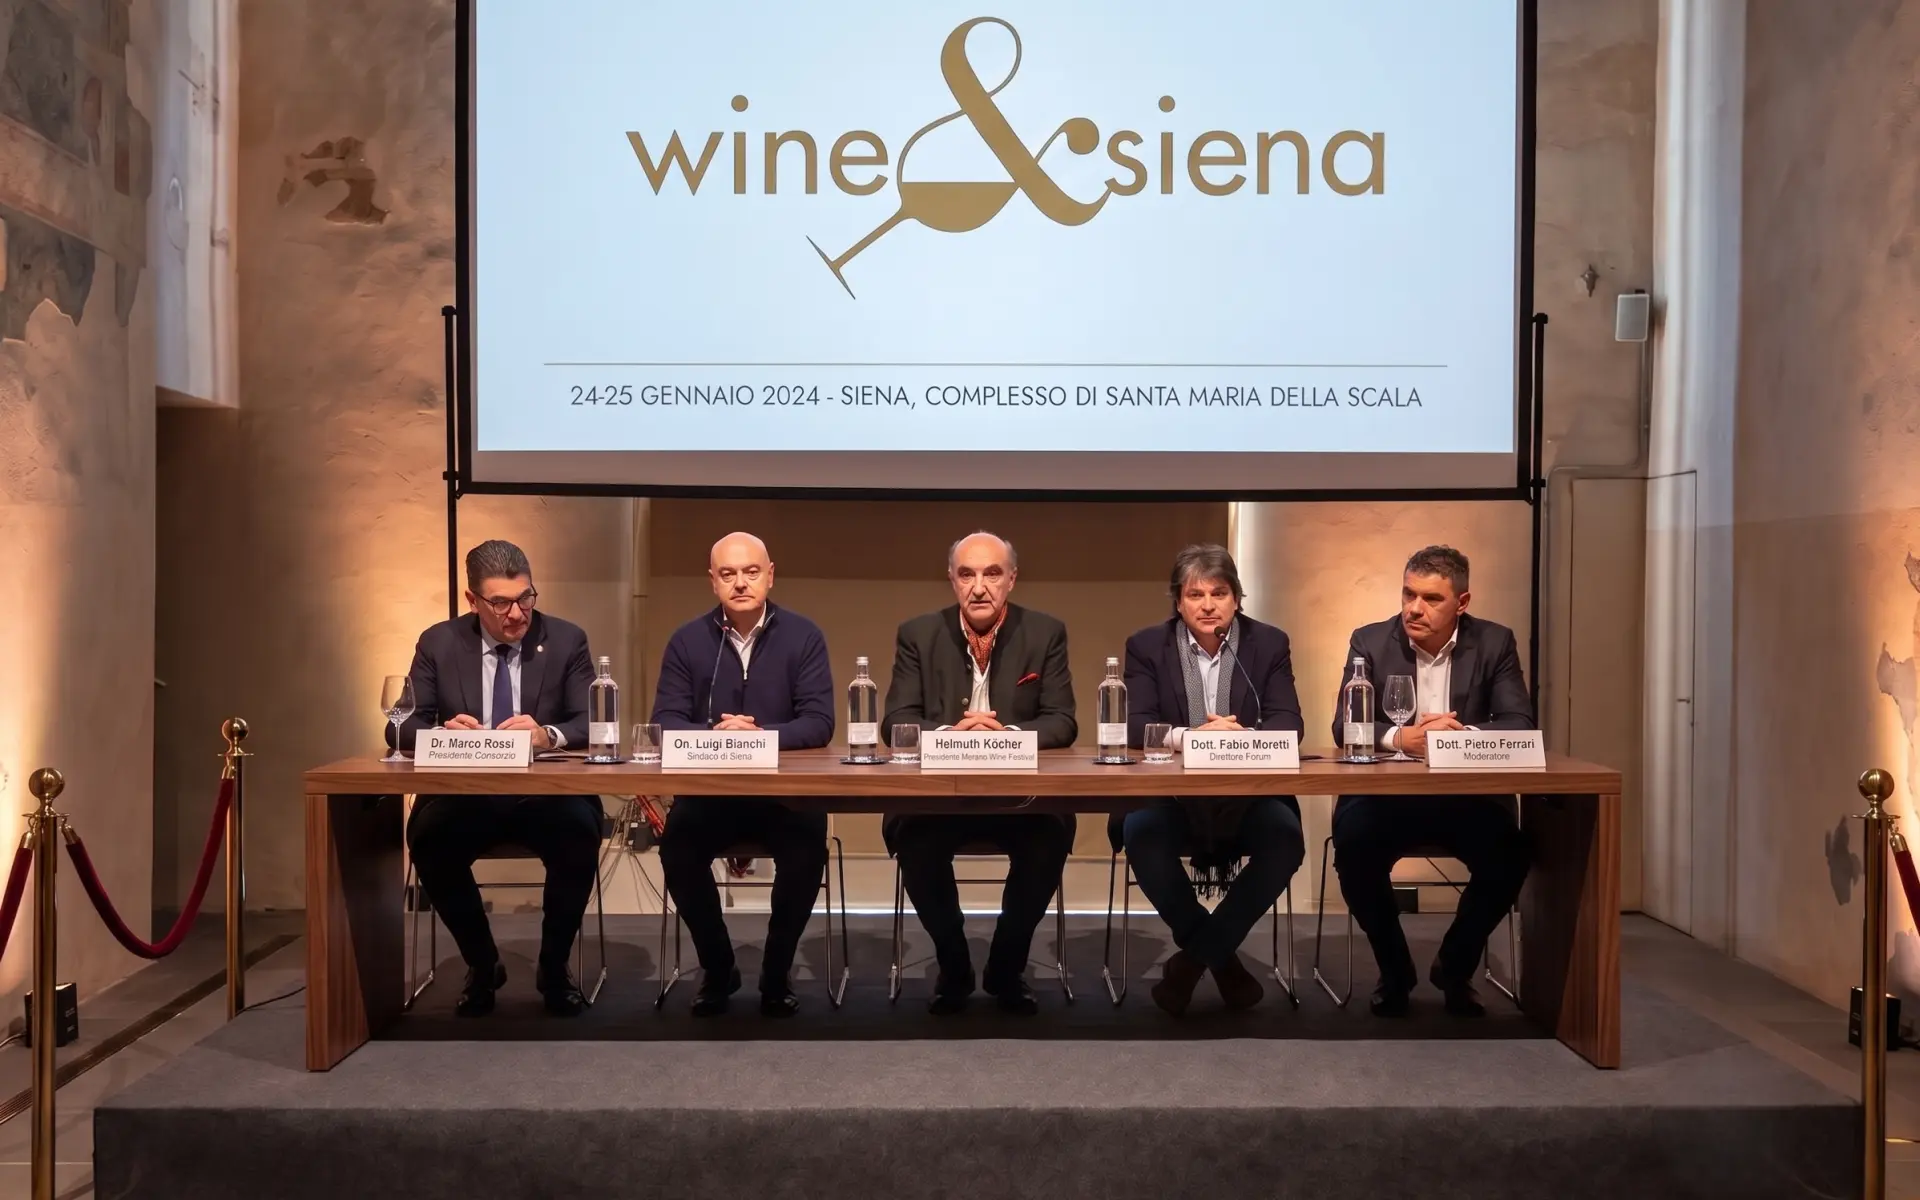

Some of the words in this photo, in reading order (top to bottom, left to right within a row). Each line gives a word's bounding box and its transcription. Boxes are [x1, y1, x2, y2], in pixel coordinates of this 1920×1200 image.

[570, 385, 633, 406] 24-25
[640, 384, 755, 406] GENNAIO
[762, 385, 820, 406] 2024
[841, 385, 916, 410] SIENA,
[925, 385, 1067, 407] COMPLESSO
[1076, 386, 1097, 406] DI
[1106, 385, 1181, 407] SANTA
[1188, 386, 1262, 407] MARIA
[1271, 386, 1340, 407] DELLA
[1347, 386, 1423, 408] SCALA
[431, 738, 446, 749] Dr.
[448, 738, 481, 749] Marco
[484, 738, 514, 749] Rossi
[674, 738, 693, 749] On.
[696, 738, 722, 751] Luigi
[725, 738, 766, 749] Bianchi
[935, 738, 980, 749] Helmuth
[983, 738, 1022, 749] Köcher
[1191, 739, 1217, 750] Dott.
[1219, 739, 1249, 750] Fabio
[1252, 739, 1290, 750] Moretti
[1436, 738, 1462, 749] Dott.
[1465, 739, 1497, 749] Pietro
[1499, 738, 1535, 749] Ferrari
[428, 751, 473, 760] Presidente
[474, 751, 516, 760] Consorzio
[687, 752, 719, 761] Sindaco
[720, 752, 728, 761] di
[729, 752, 753, 761] Siena
[923, 753, 960, 761] Presidente
[961, 753, 988, 761] Merano
[989, 753, 1006, 761] Wine
[1008, 753, 1035, 761] Festival
[1209, 752, 1244, 761] Direttore
[1245, 752, 1272, 761] Forum
[1463, 752, 1511, 761] Moderatore
